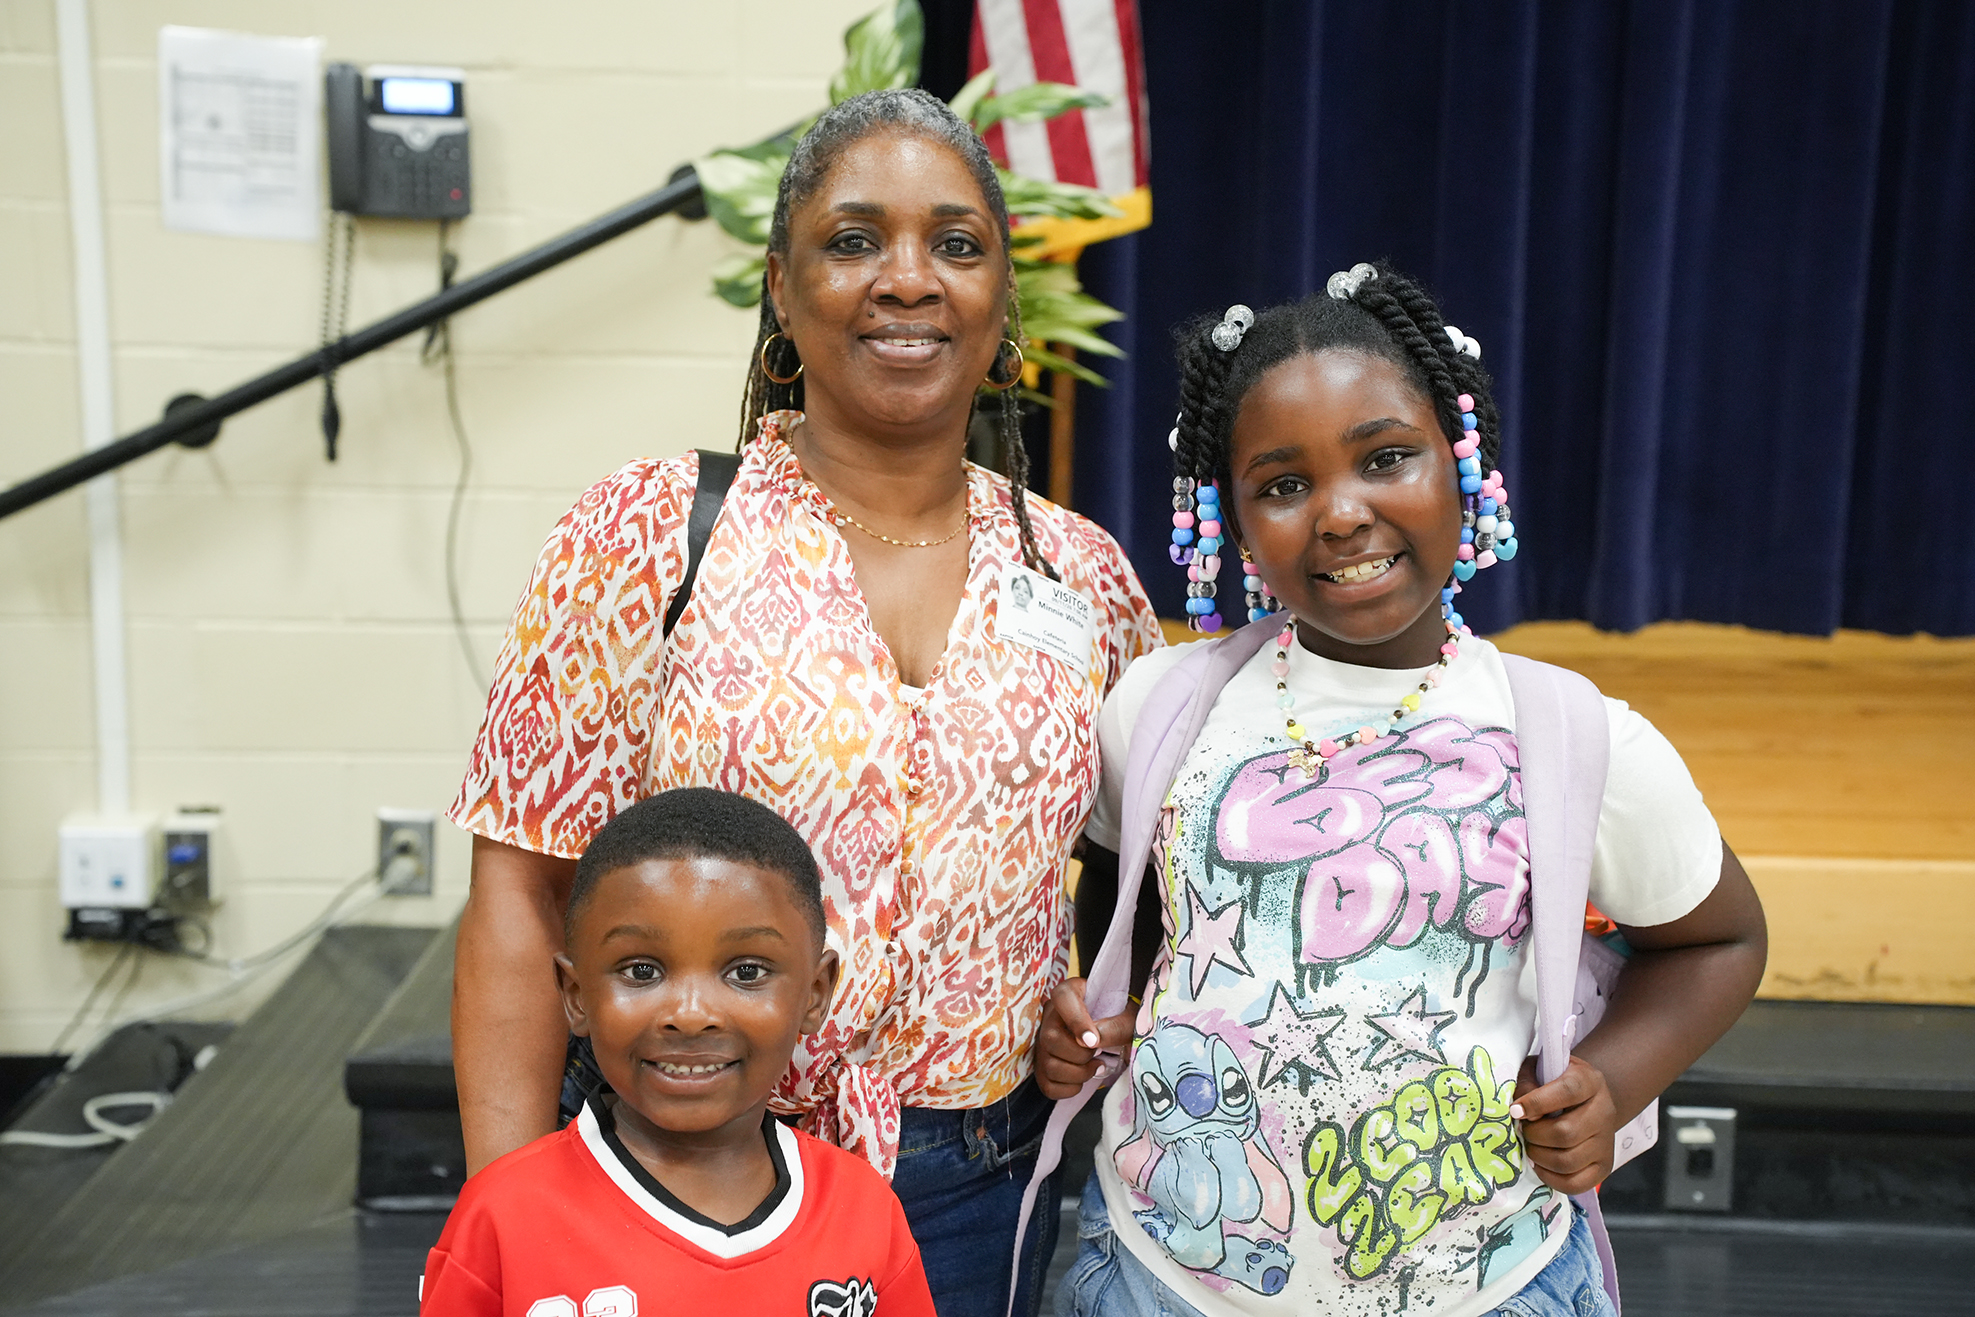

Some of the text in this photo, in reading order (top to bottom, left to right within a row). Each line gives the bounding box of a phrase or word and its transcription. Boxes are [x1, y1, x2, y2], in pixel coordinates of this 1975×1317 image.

[1038, 601, 1064, 618] Minnie
[1065, 613, 1084, 629] White
[1052, 587, 1089, 615] VISITOR
[1302, 1045, 1517, 1228] 2 COOL
